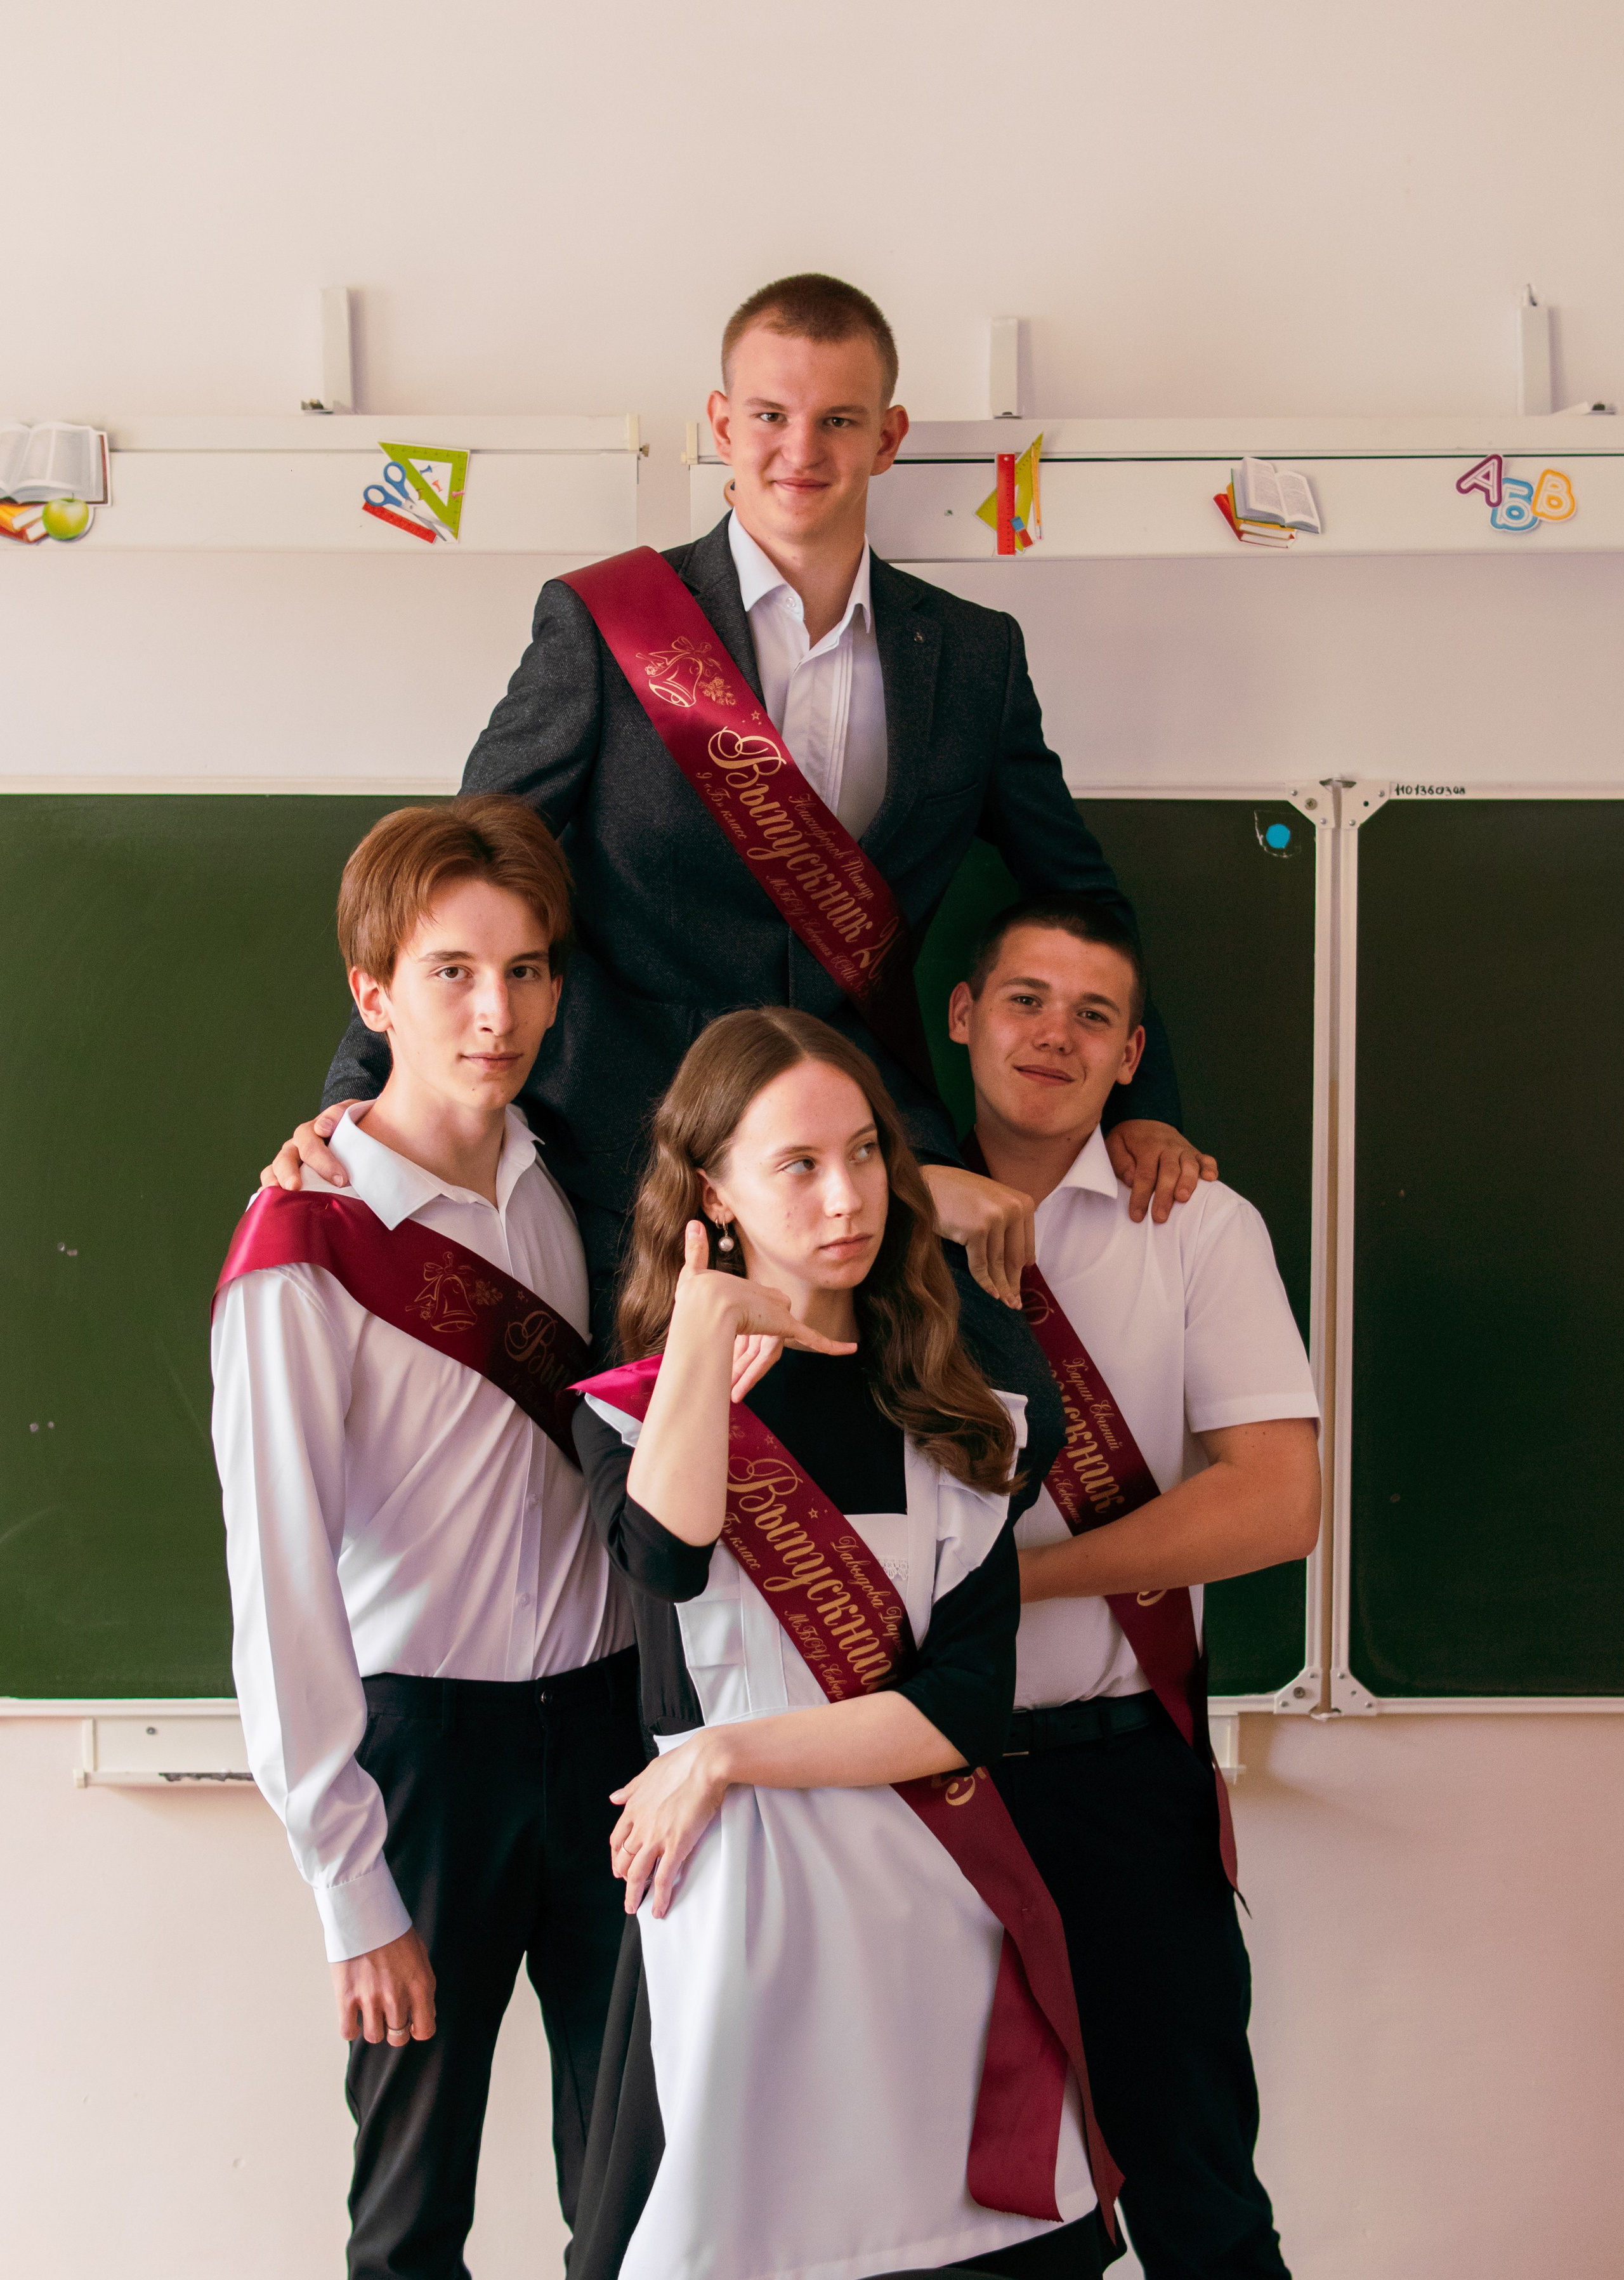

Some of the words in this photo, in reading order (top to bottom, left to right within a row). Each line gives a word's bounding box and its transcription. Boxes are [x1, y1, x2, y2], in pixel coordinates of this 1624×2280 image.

[708, 726, 873, 943] Выпускник
[721, 811, 747, 840] класс
[788, 793, 855, 859] Никифоров
[840, 857, 874, 900] Тимур
[1063, 1358, 1094, 1403] Харин
[1090, 1400, 1123, 1451] Евгений
[730, 1538, 761, 1571] класс
[830, 1536, 891, 1609] Давыдова
[784, 1611, 830, 1661] МБОУ
